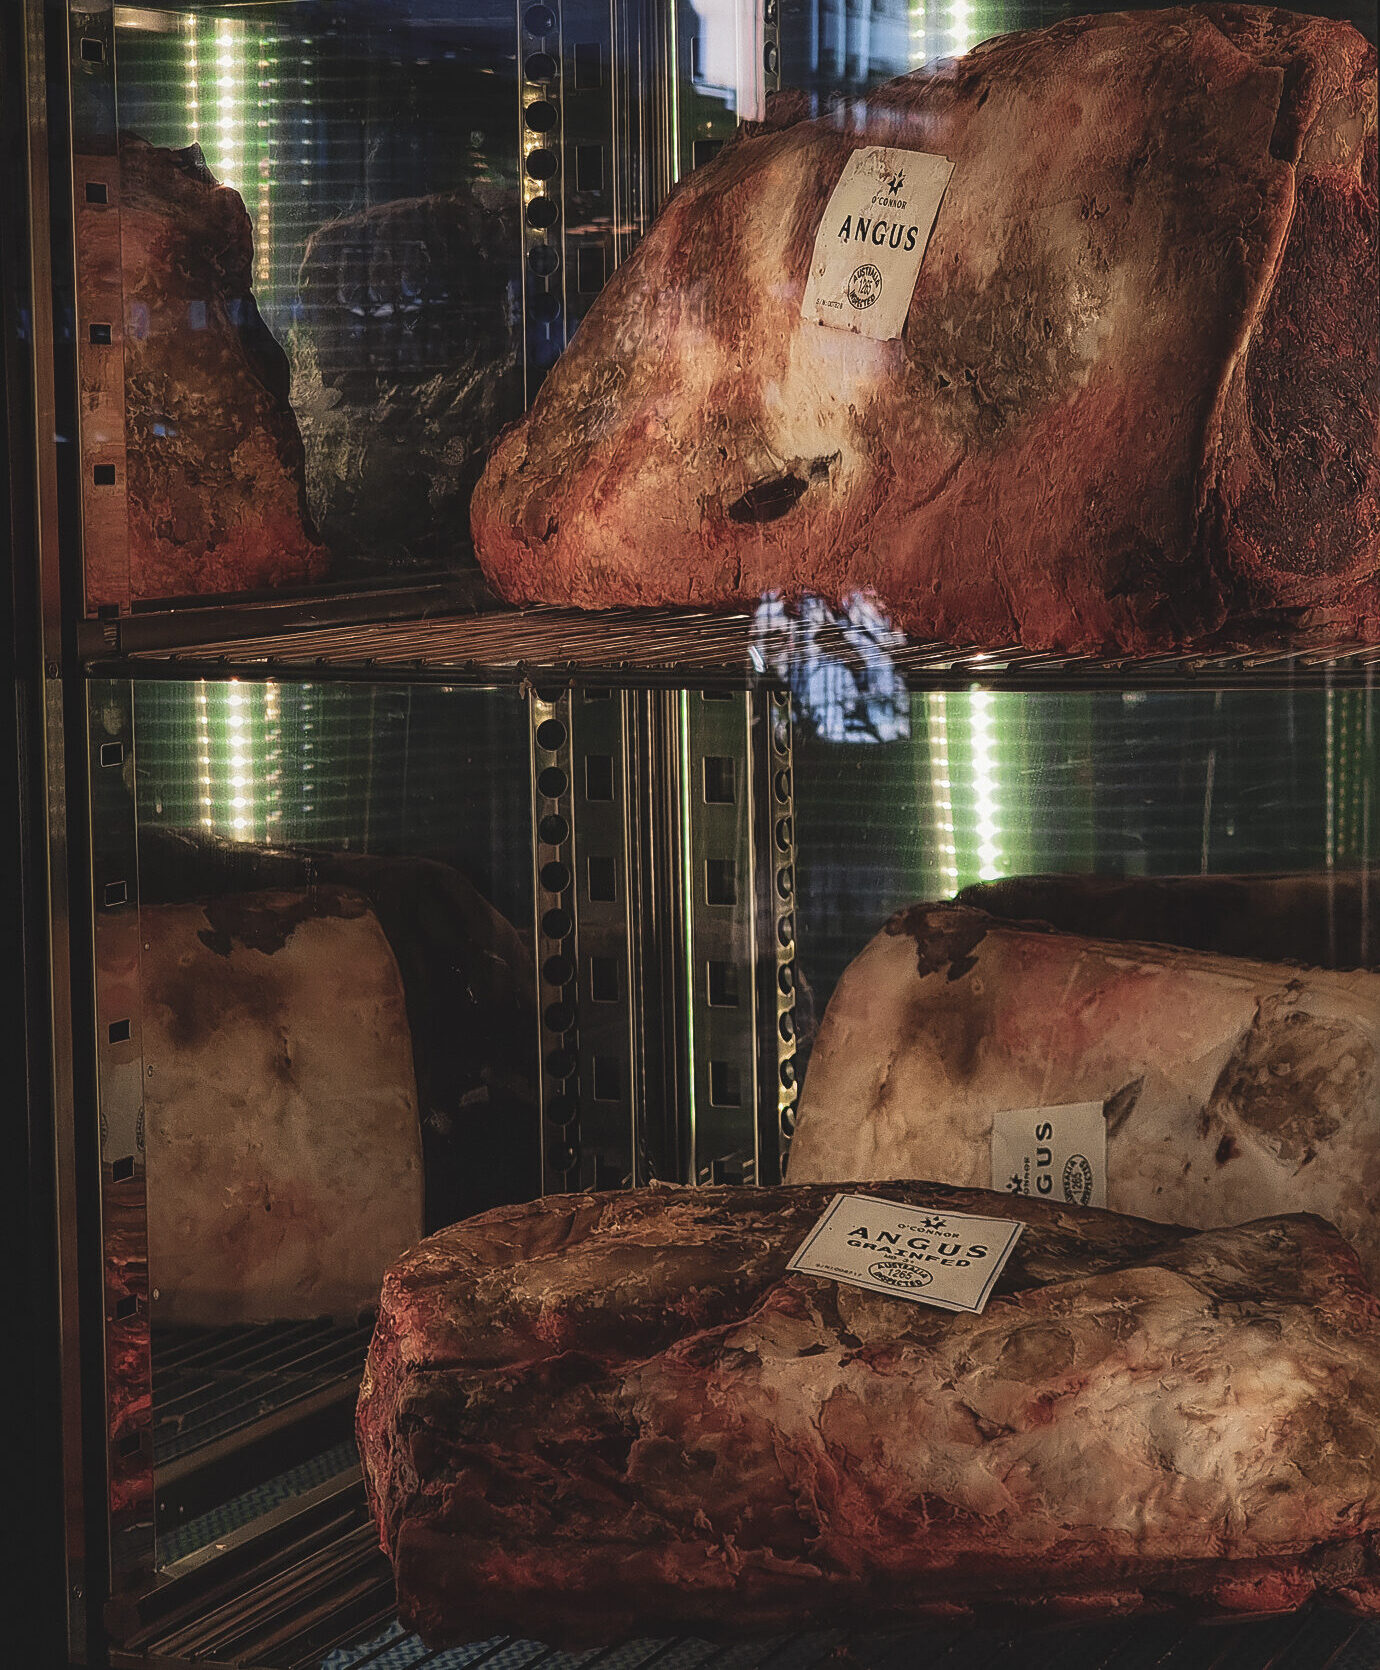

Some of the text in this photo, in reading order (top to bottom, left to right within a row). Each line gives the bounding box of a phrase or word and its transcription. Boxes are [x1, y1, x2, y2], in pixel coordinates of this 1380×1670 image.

[872, 195, 908, 210] O'CONNOR
[838, 214, 919, 252] ANGUS
[1035, 1122, 1053, 1194] GUS
[897, 1222, 960, 1239] O'CONNOR
[847, 1226, 989, 1259] ANGUS
[846, 1239, 971, 1268] GRAINFED
[873, 1271, 923, 1288] INSPECTED
[877, 1261, 929, 1280] AUSTRALIA
[887, 1268, 914, 1280] 1265
